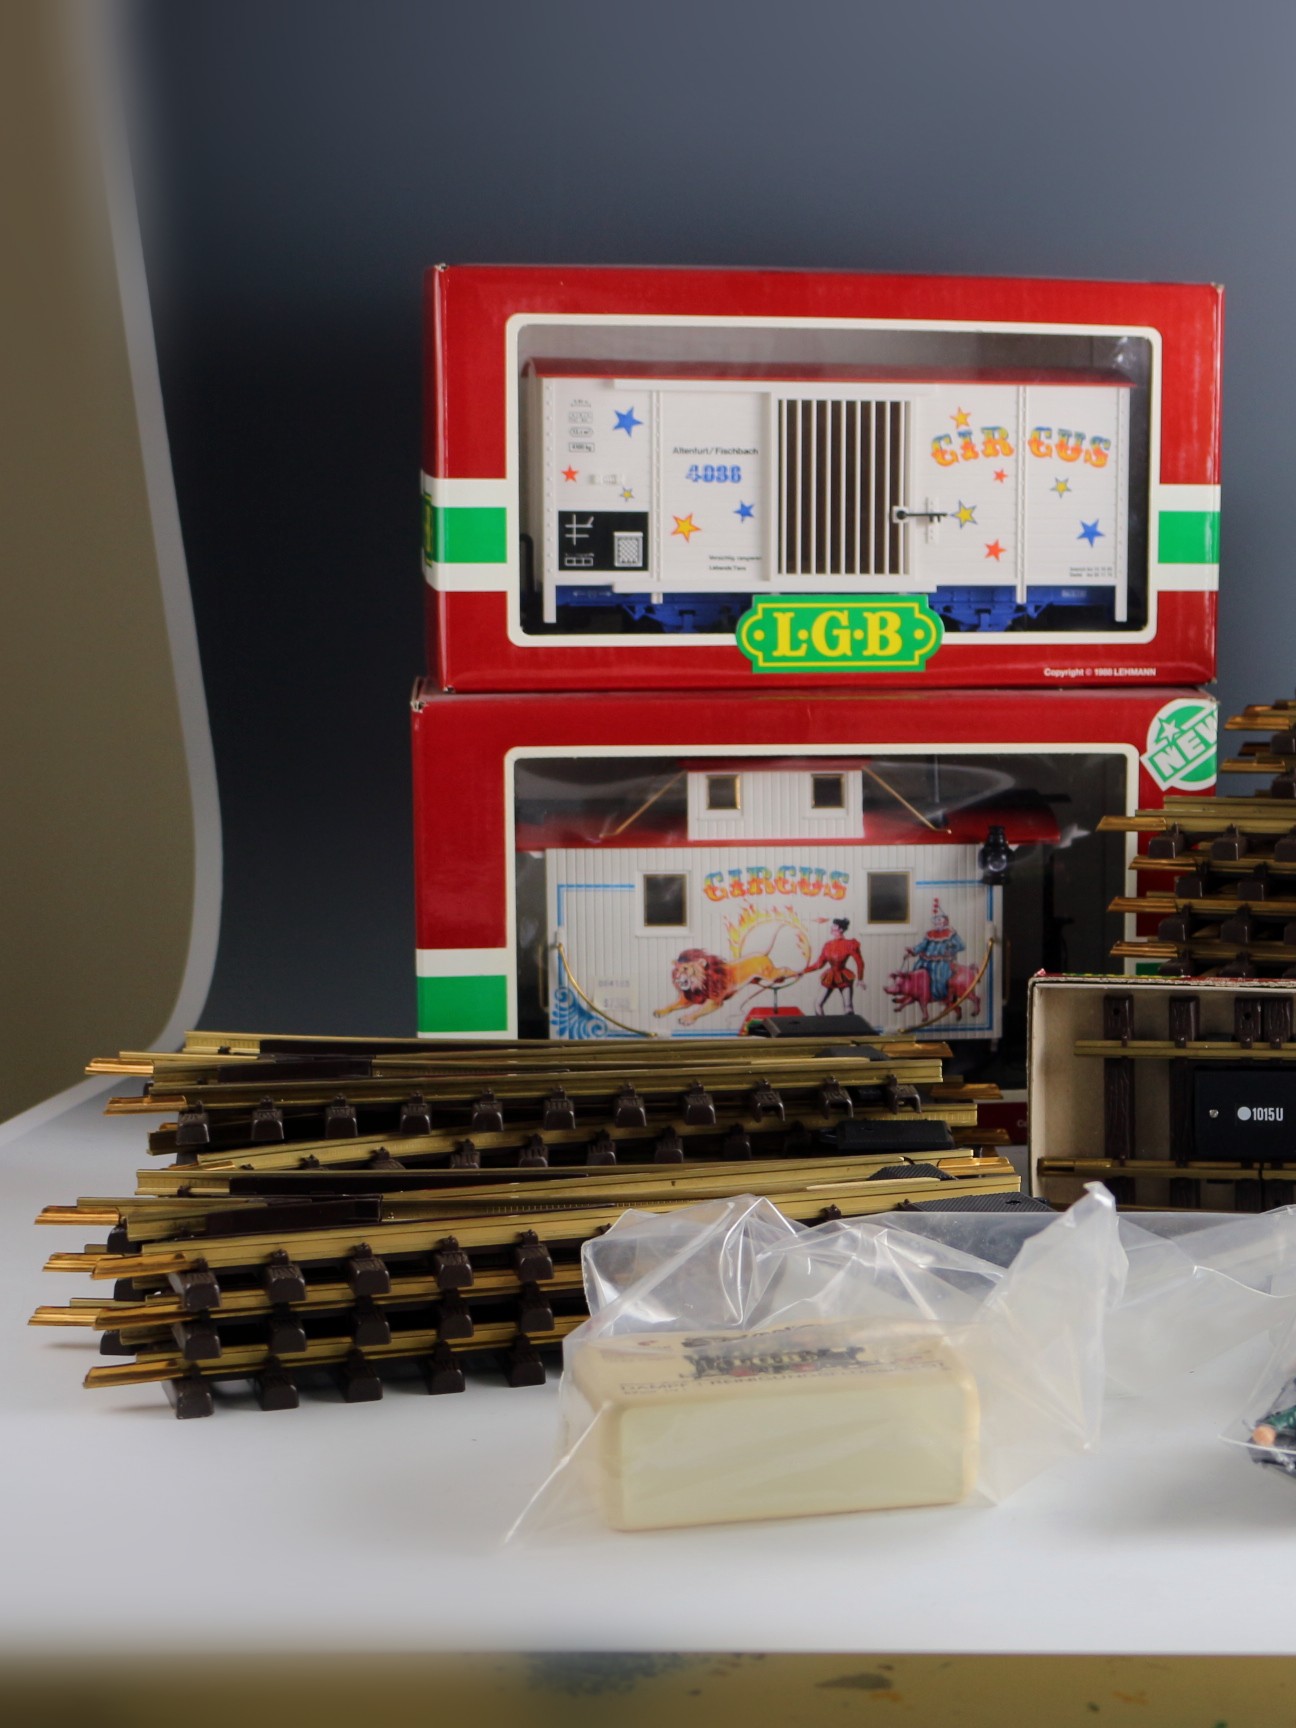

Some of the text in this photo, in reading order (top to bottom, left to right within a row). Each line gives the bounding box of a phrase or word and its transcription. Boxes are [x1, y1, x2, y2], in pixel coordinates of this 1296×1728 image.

[1043, 667, 1085, 678] Copyright
[1114, 667, 1157, 677] LEHMANN
[703, 865, 849, 901] CIRCUS
